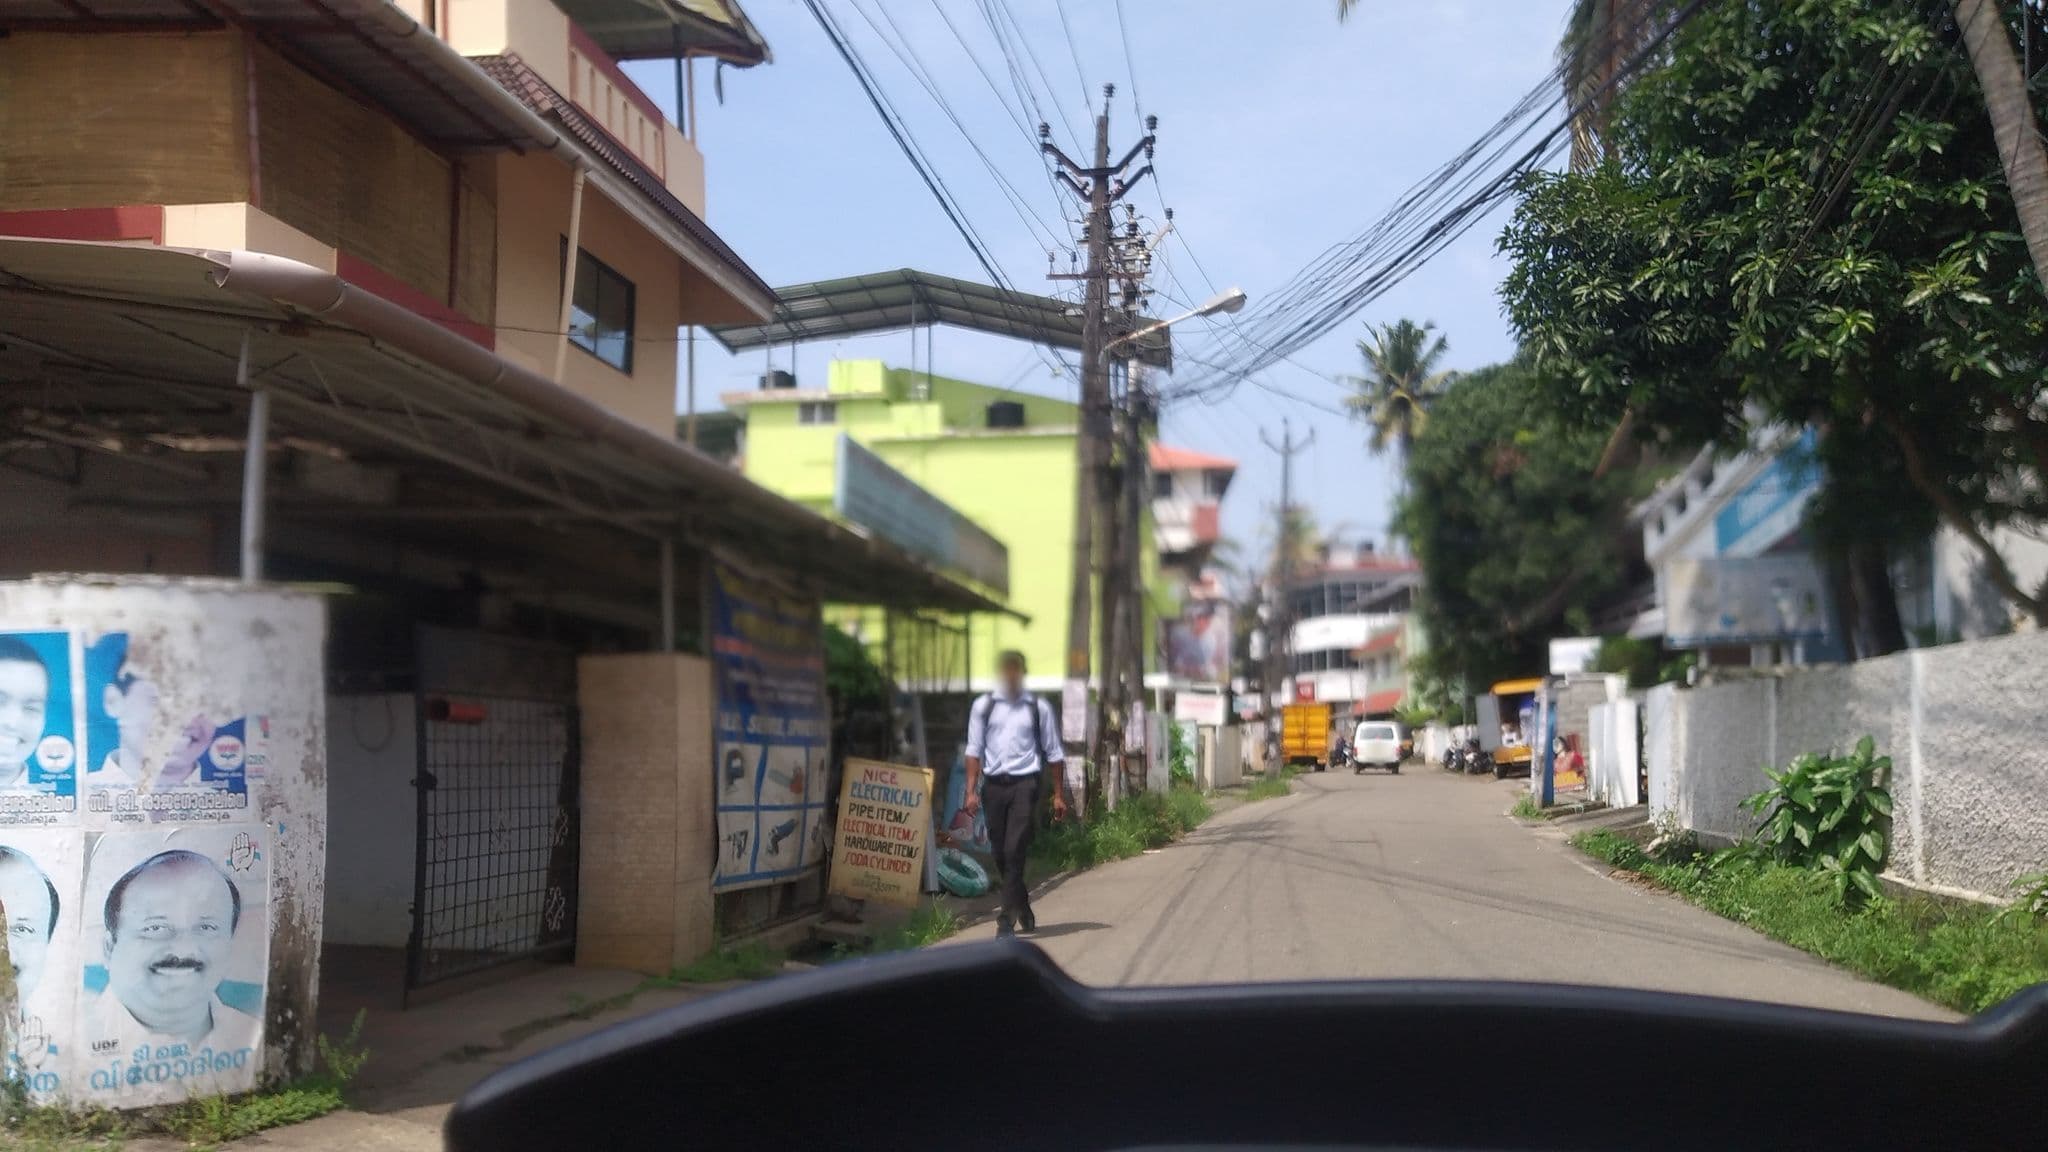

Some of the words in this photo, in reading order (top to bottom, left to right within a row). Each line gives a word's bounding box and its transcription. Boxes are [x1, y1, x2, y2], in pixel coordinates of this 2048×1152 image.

[864, 769, 898, 784] NICE
[850, 782, 922, 807] ELECTRICALS
[848, 803, 875, 817] PIPE
[876, 808, 910, 824] ITEMS
[843, 818, 886, 837] ELECTRICAL
[888, 826, 918, 841] ITEMS
[844, 836, 893, 854] HARDWARE
[870, 855, 912, 874] CYLINDER
[91, 1039, 119, 1052] UDF
